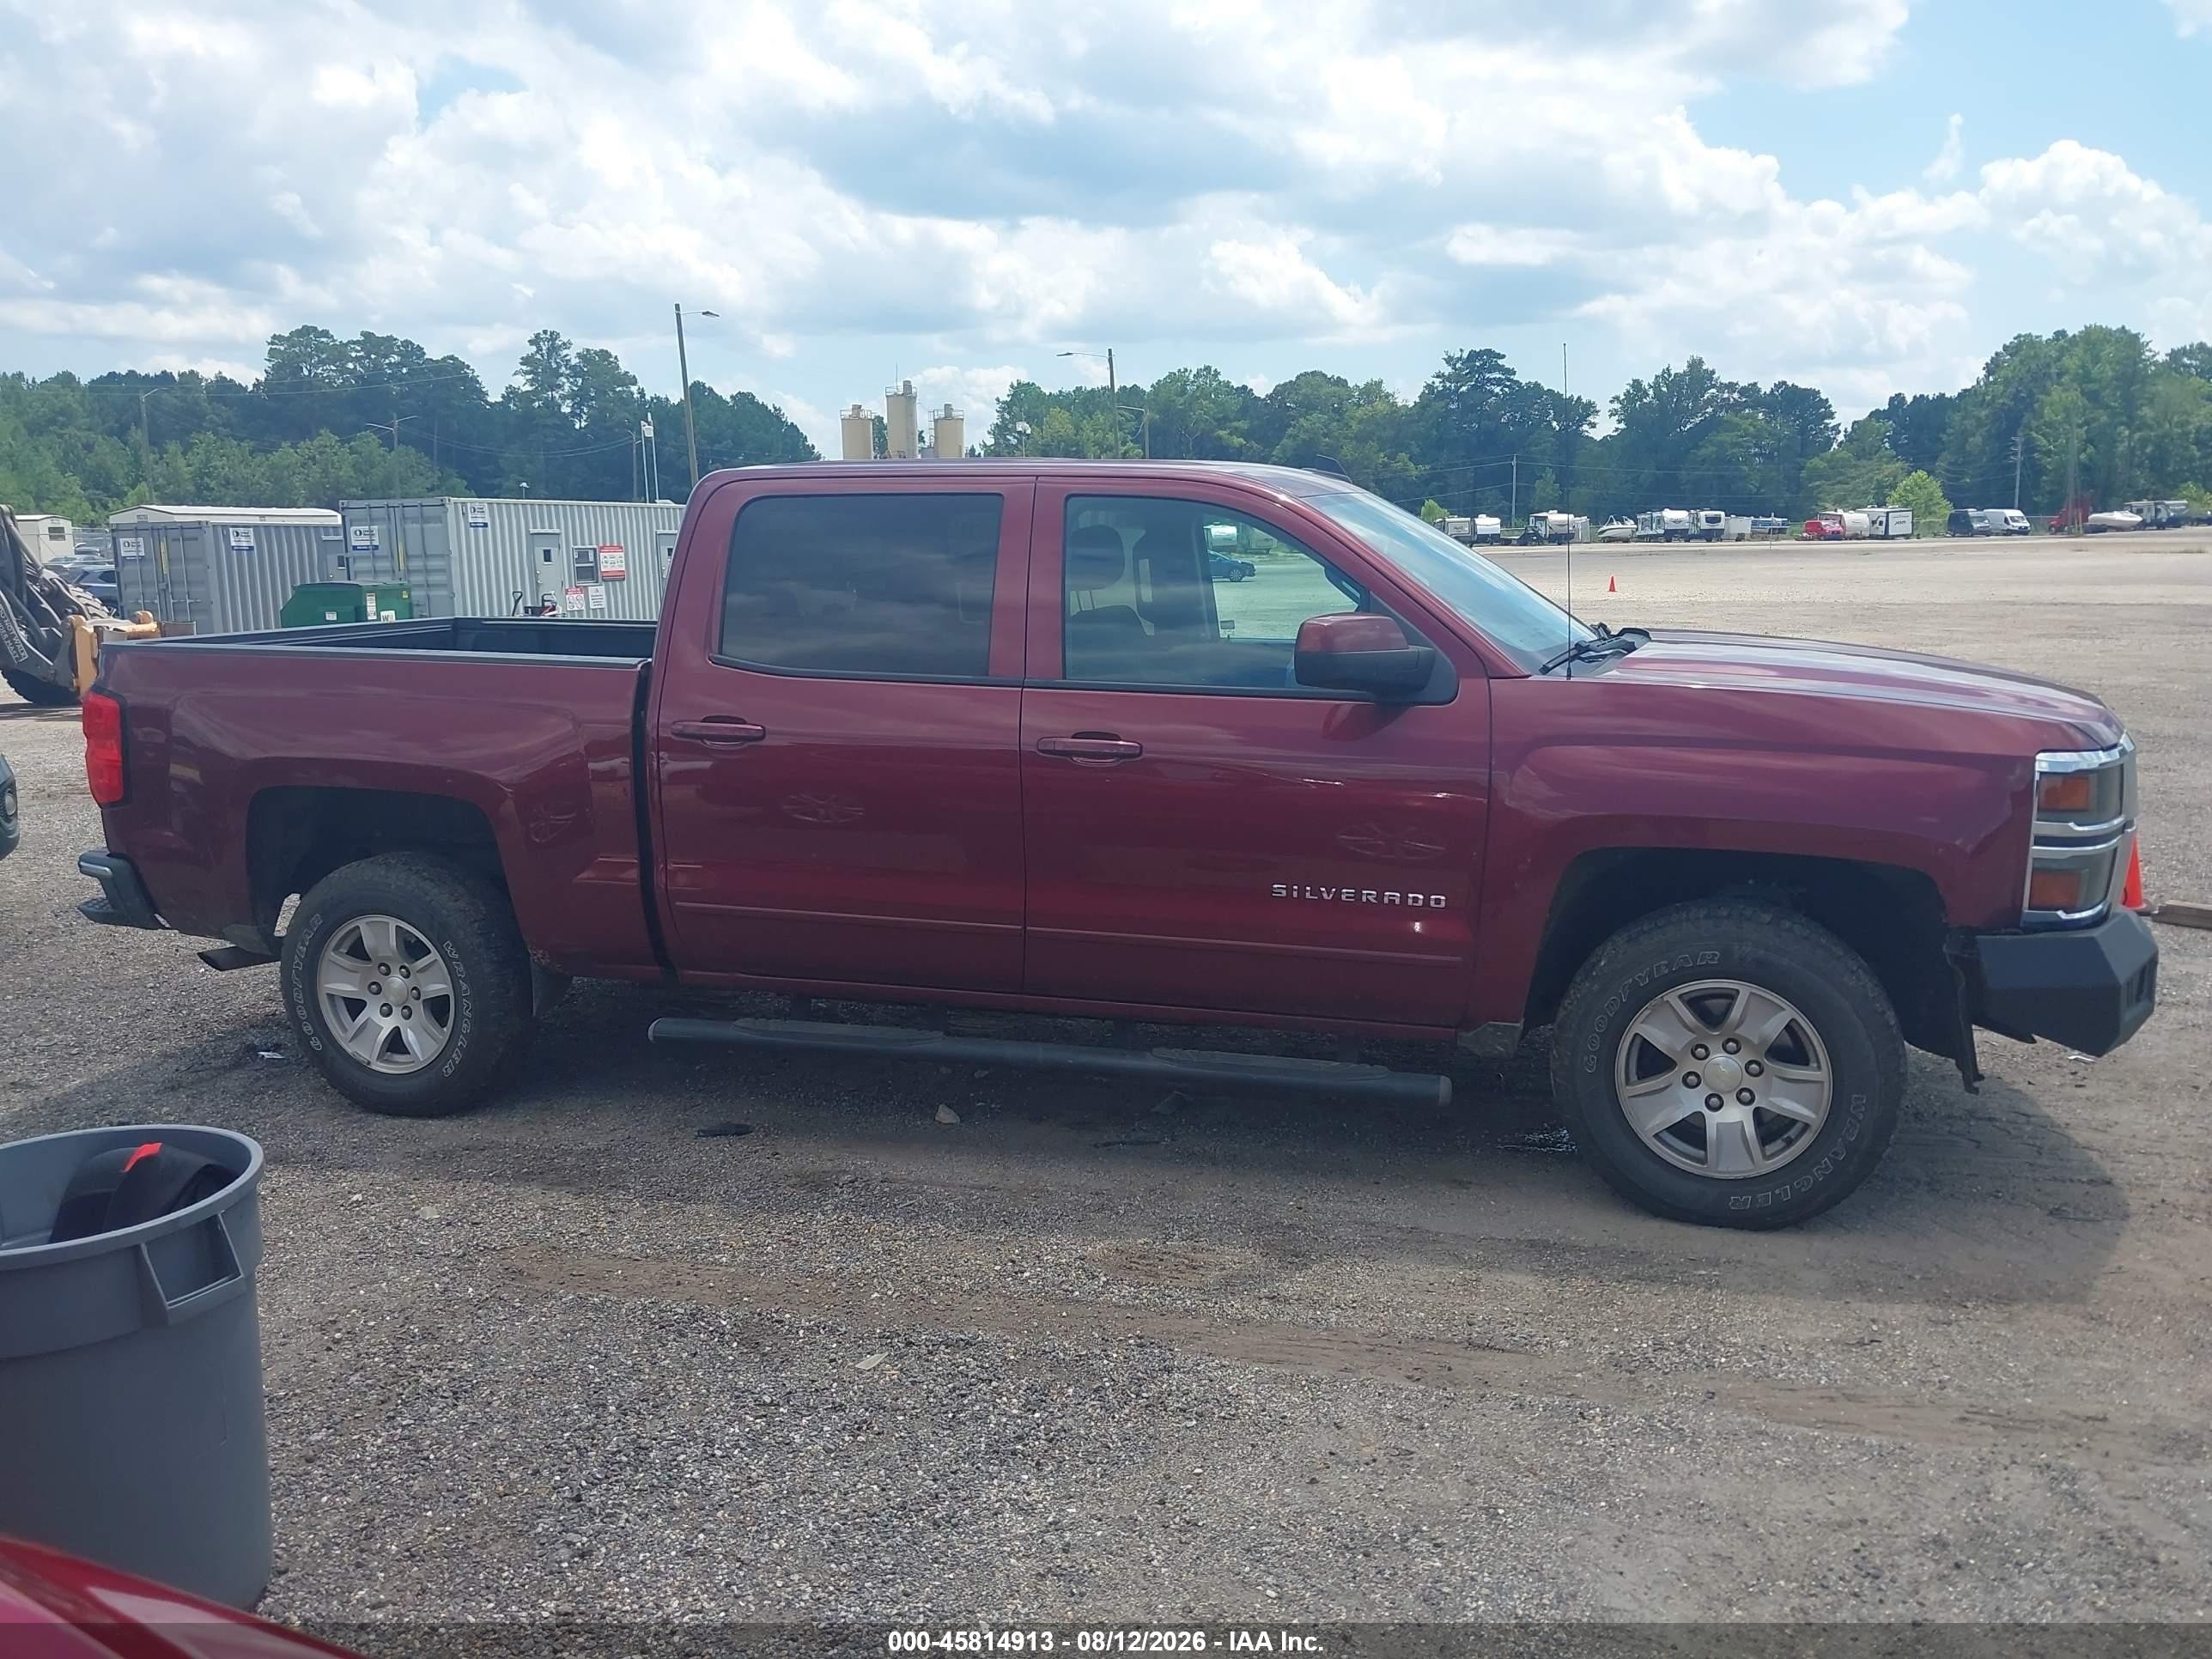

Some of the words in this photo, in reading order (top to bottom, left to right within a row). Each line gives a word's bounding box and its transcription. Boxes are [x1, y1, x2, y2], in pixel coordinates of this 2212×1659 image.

[13, 635, 27, 658] WALK
[1272, 884, 1447, 908] SILVERADO
[291, 914, 324, 1052] GOODYEAR
[441, 940, 474, 1078] WRANGLER
[1584, 951, 1721, 1074] GOODYEAR
[1729, 1094, 1867, 1210] WRANGLER
